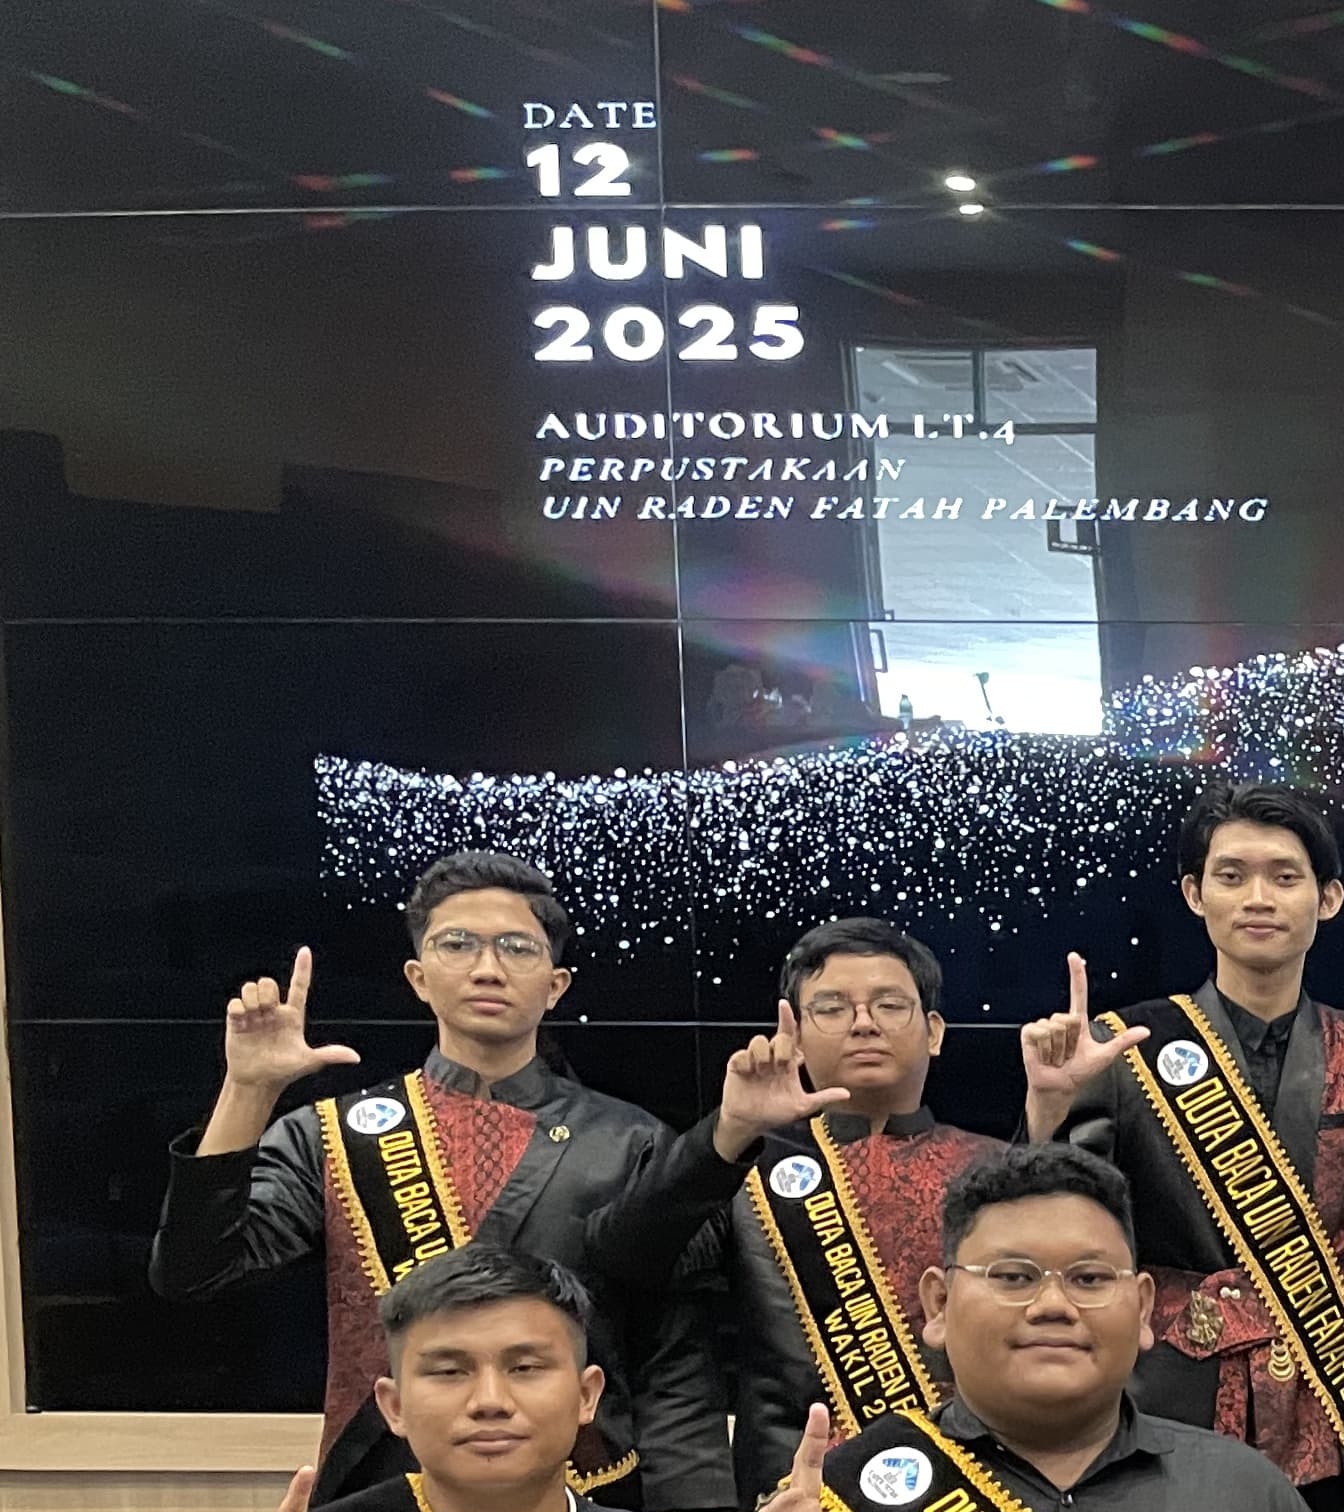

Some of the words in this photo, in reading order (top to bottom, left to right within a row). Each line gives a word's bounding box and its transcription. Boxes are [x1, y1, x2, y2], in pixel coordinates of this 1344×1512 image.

[523, 102, 657, 129] DATE
[526, 141, 632, 197] 12
[531, 225, 764, 281] JUNI
[533, 304, 805, 362] 2025
[535, 412, 890, 441] AUDITORIUM
[538, 457, 907, 482] PERPUSTAKAAN
[542, 495, 622, 520] UIN
[637, 495, 795, 520] RADEN
[809, 496, 964, 520] FATAH
[980, 497, 1269, 522] PALEMBANG
[1174, 1075, 1243, 1154] DUTA
[378, 1130, 412, 1186] DUTA
[397, 1182, 441, 1243] BACA
[1210, 1137, 1272, 1216] BACA
[804, 1190, 843, 1246] DUTA
[1242, 1194, 1300, 1250] UIN
[825, 1242, 866, 1298] BACA
[1264, 1232, 1332, 1320] RADEN
[844, 1292, 883, 1330] UIN
[823, 1307, 871, 1398] WAKIL
[863, 1399, 888, 1420] 2
[858, 1326, 911, 1397] RADEN
